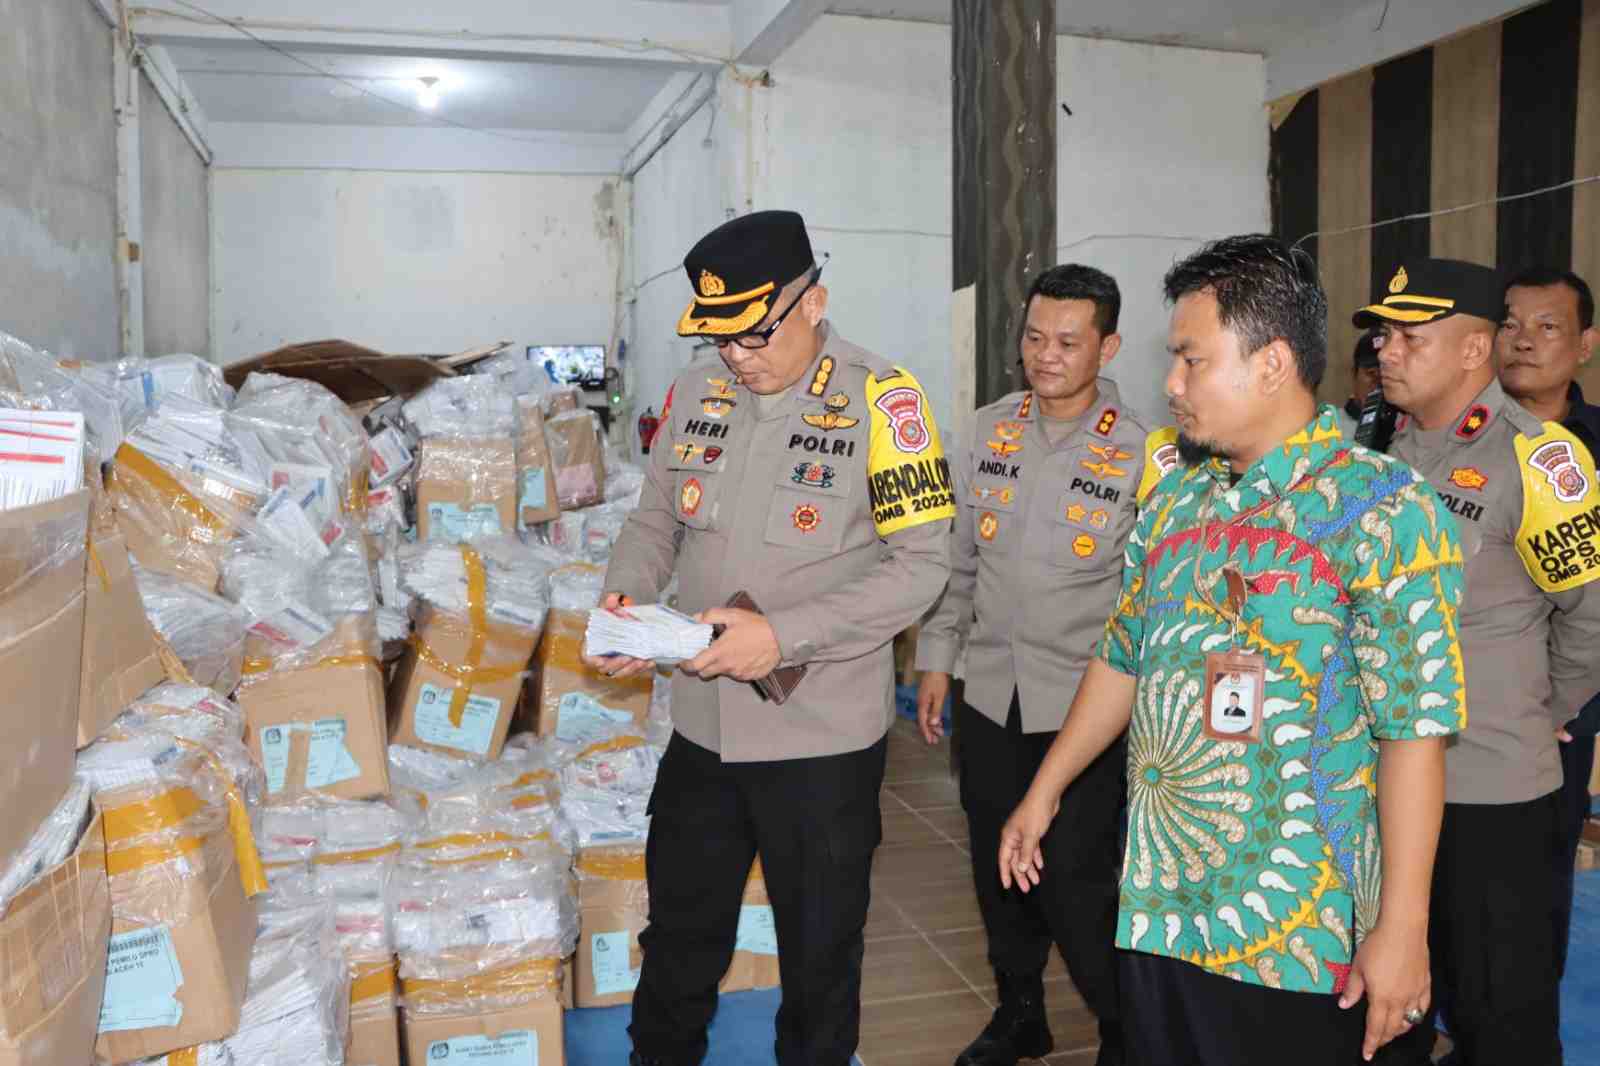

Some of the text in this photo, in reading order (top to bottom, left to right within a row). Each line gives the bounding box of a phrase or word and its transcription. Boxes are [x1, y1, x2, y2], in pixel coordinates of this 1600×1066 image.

[684, 419, 729, 440] HERI
[788, 434, 856, 458] POLRI
[1070, 477, 1121, 504] POLRI
[874, 504, 906, 524] OMB
[1540, 540, 1596, 573] OPS
[1547, 563, 1583, 584] OMB
